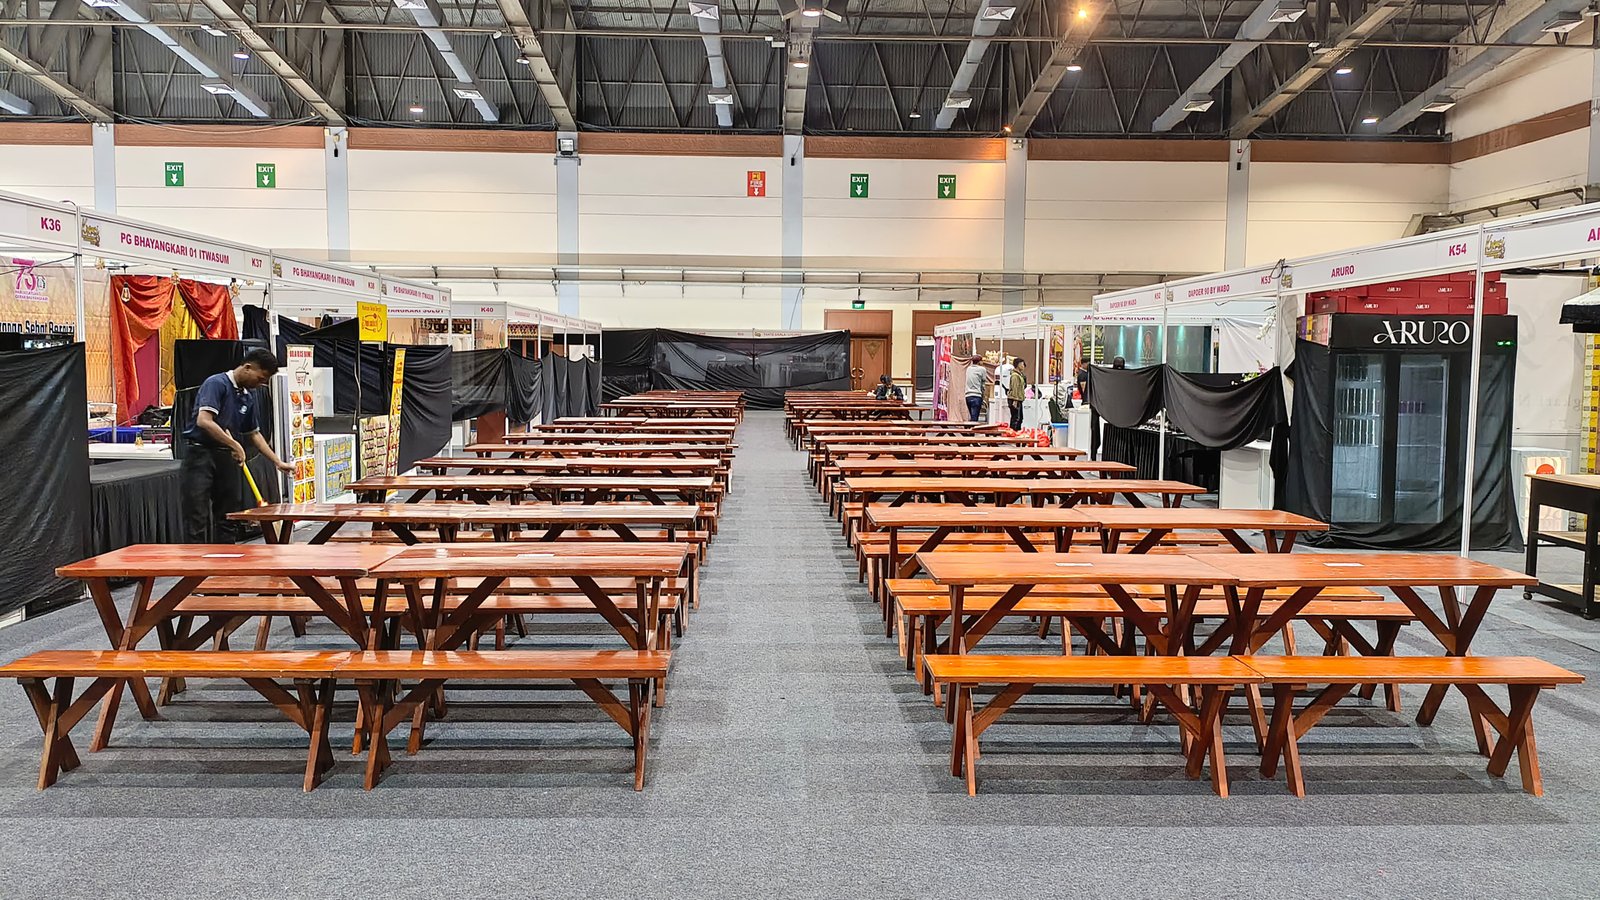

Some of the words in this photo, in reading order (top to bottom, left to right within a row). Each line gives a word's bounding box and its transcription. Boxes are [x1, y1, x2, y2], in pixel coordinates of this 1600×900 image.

[41, 217, 61, 231] K36
[120, 233, 132, 245] PG
[134, 235, 187, 256] BHAYANGKARI
[189, 248, 197, 258] 01
[199, 250, 230, 264] ITWASUM
[1449, 243, 1467, 256] K54
[251, 257, 262, 268] K37
[292, 267, 300, 276] PG
[1331, 265, 1355, 278] ARURO
[1260, 276, 1272, 285] K53
[1210, 286, 1217, 295] BY
[1217, 284, 1230, 294] WABO
[1373, 320, 1470, 345] ARURO
